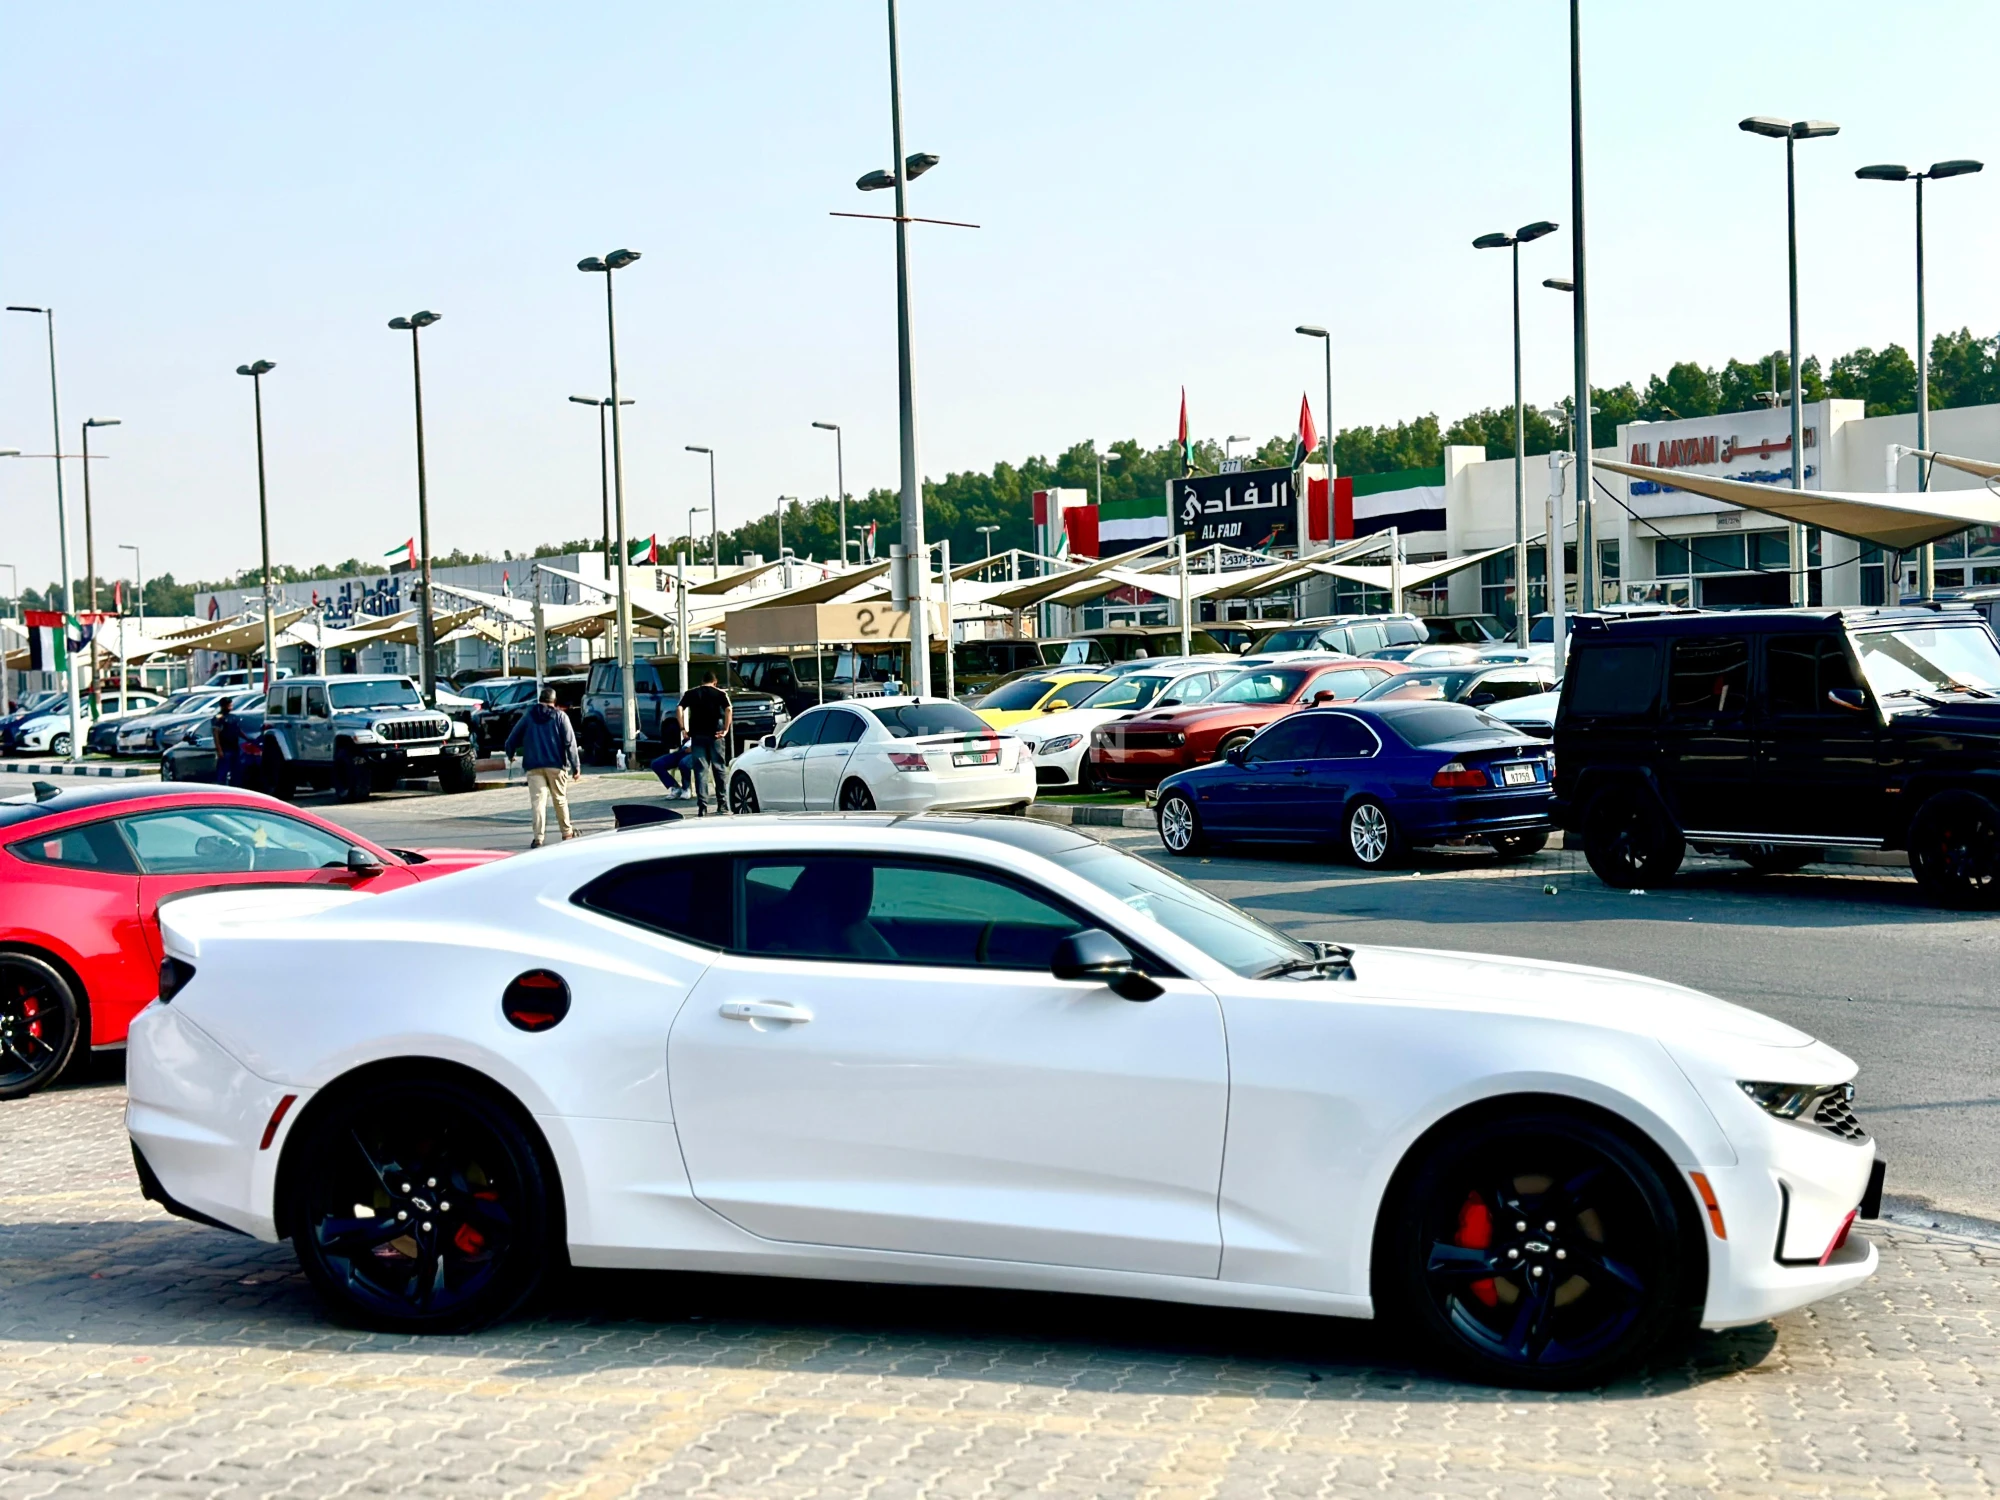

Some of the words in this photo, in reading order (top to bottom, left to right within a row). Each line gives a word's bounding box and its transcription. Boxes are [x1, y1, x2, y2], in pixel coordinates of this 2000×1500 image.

[1222, 461, 1238, 472] 277
[1202, 525, 1216, 540] AL
[1217, 522, 1242, 538] FADI
